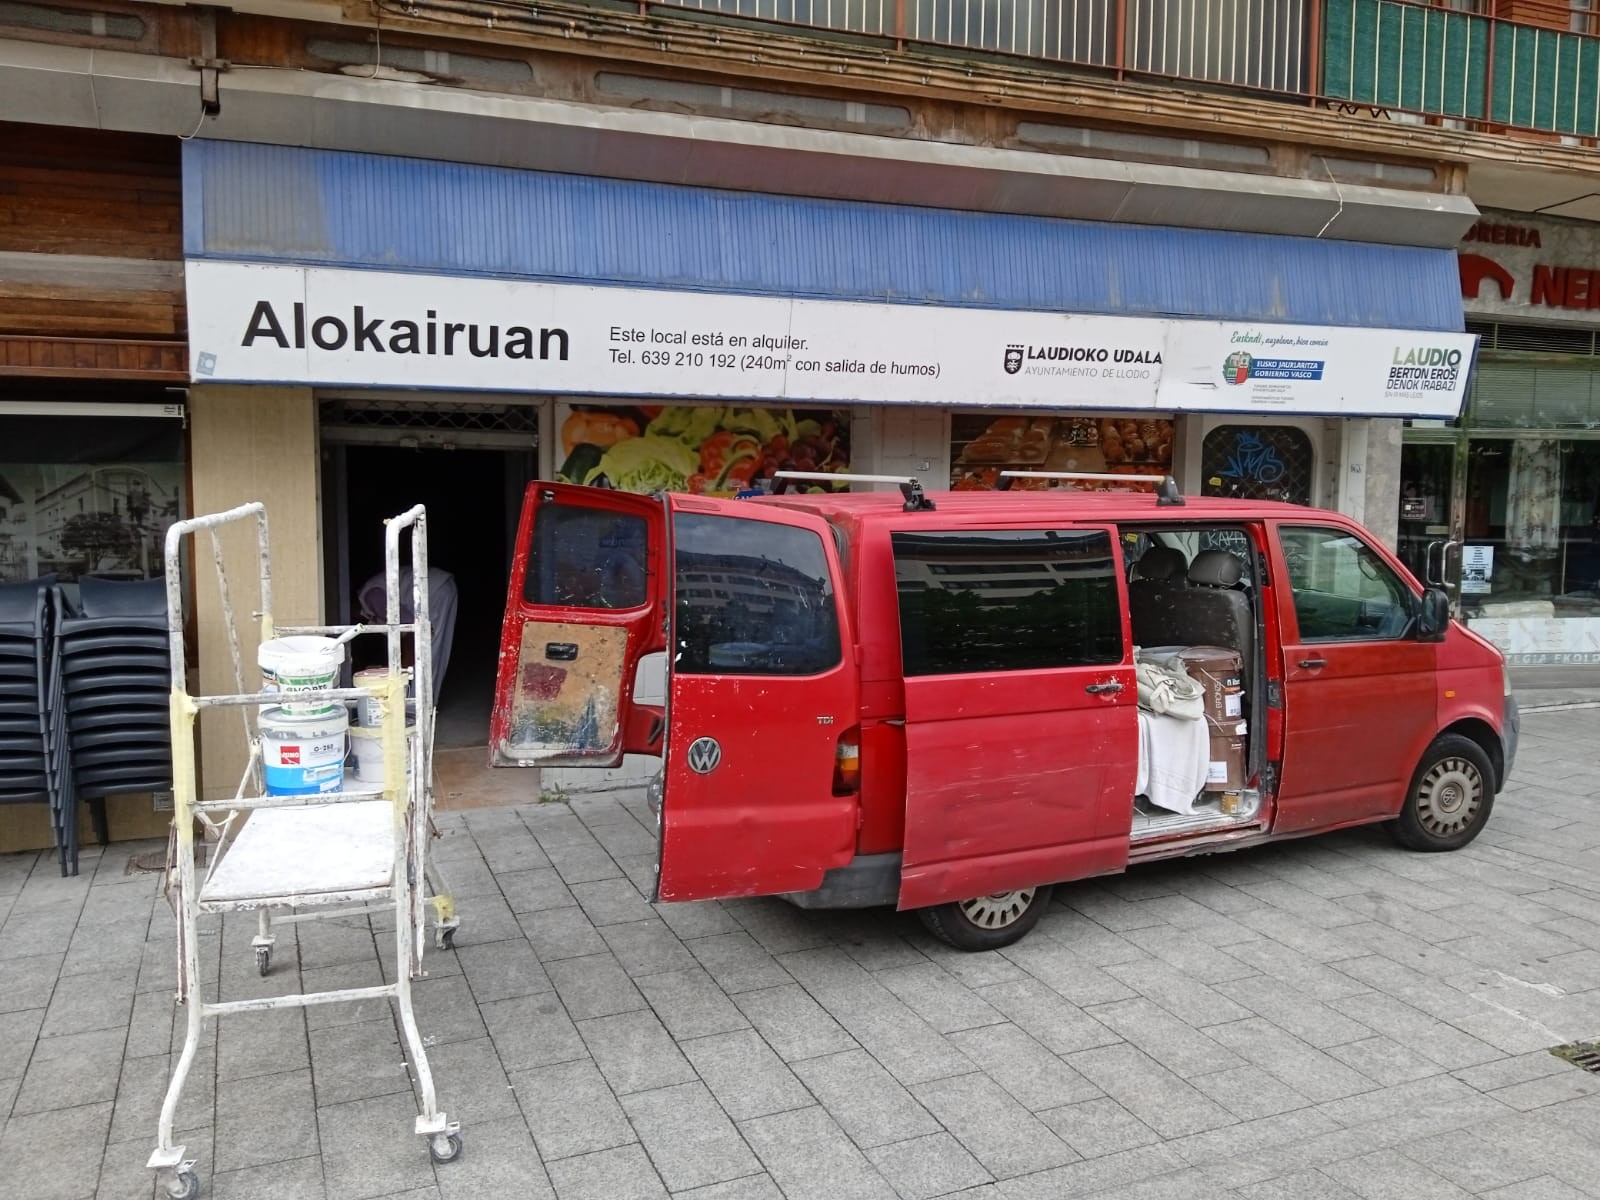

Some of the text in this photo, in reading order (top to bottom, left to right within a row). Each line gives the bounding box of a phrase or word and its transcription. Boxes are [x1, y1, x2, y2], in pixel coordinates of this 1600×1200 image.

[241, 299, 569, 361] Alokairuan
[609, 326, 809, 352] Este local está en alquiler.
[609, 348, 635, 364] Tel.
[641, 350, 671, 366] 639
[674, 351, 704, 368] 210
[709, 353, 736, 369] 192
[795, 358, 821, 372] con
[824, 357, 866, 374] salida
[870, 359, 887, 375] de
[890, 361, 942, 379] humos)
[1027, 345, 1163, 365] LAUDIOKO UDALA
[1392, 345, 1462, 368] LAUDIO
[1025, 366, 1150, 379] AYUNTAMIENTO DE LLODIO
[1256, 360, 1277, 368] EUSKO
[1254, 370, 1312, 379] GOBIERNO VASCO
[1389, 366, 1459, 381] BERTON EROSI
[1386, 378, 1457, 392] DENOK IRABAZI
